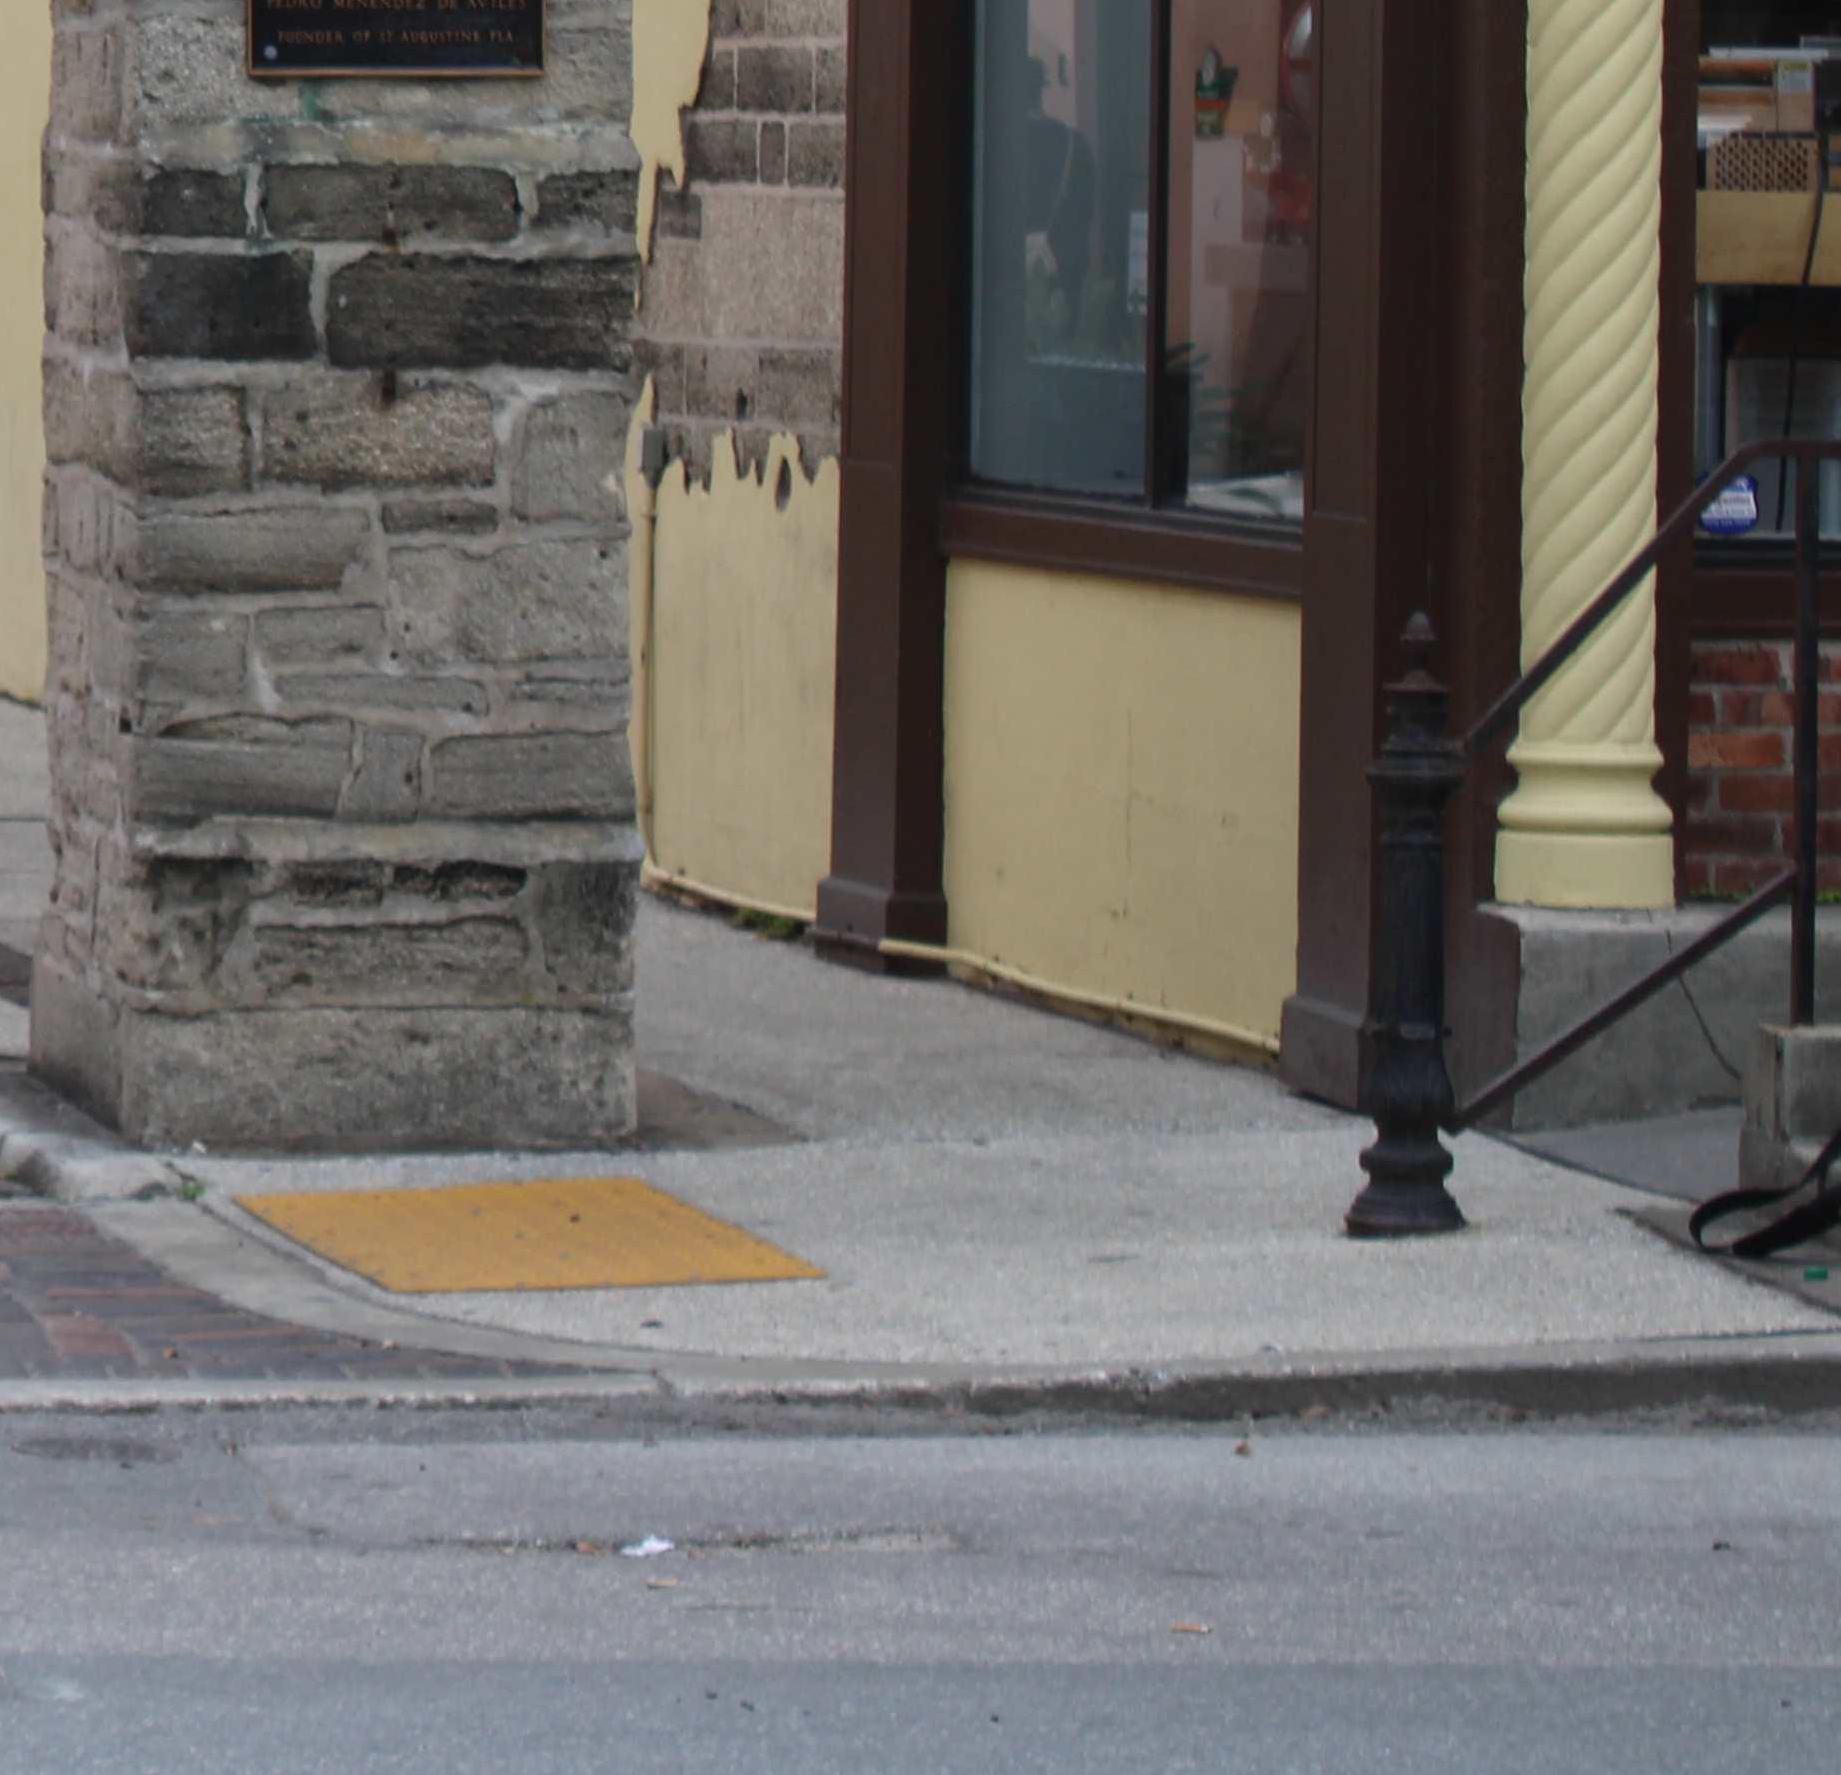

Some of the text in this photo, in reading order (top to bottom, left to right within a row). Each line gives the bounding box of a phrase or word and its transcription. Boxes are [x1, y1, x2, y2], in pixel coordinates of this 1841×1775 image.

[277, 30, 344, 44] FOUNDER
[352, 30, 372, 44] OF
[400, 30, 481, 44] AUGUSTINE
